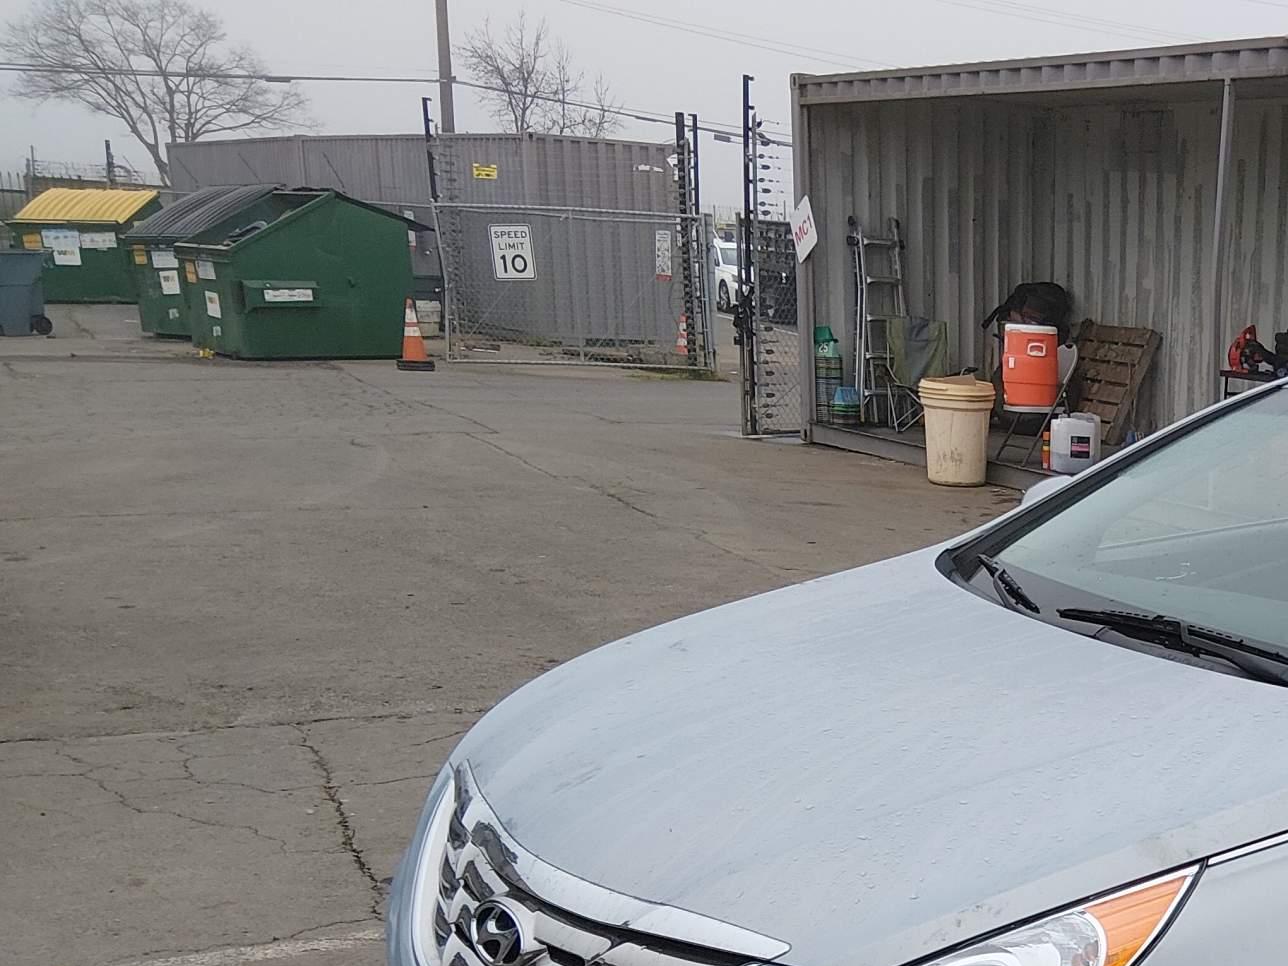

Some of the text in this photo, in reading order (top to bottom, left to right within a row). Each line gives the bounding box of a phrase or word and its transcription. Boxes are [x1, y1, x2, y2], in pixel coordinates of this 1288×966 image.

[493, 230, 528, 239] SPEED
[795, 214, 813, 247] MC1
[498, 242, 525, 251] LIMIT
[500, 254, 528, 274] 10
[818, 342, 829, 353] 25
